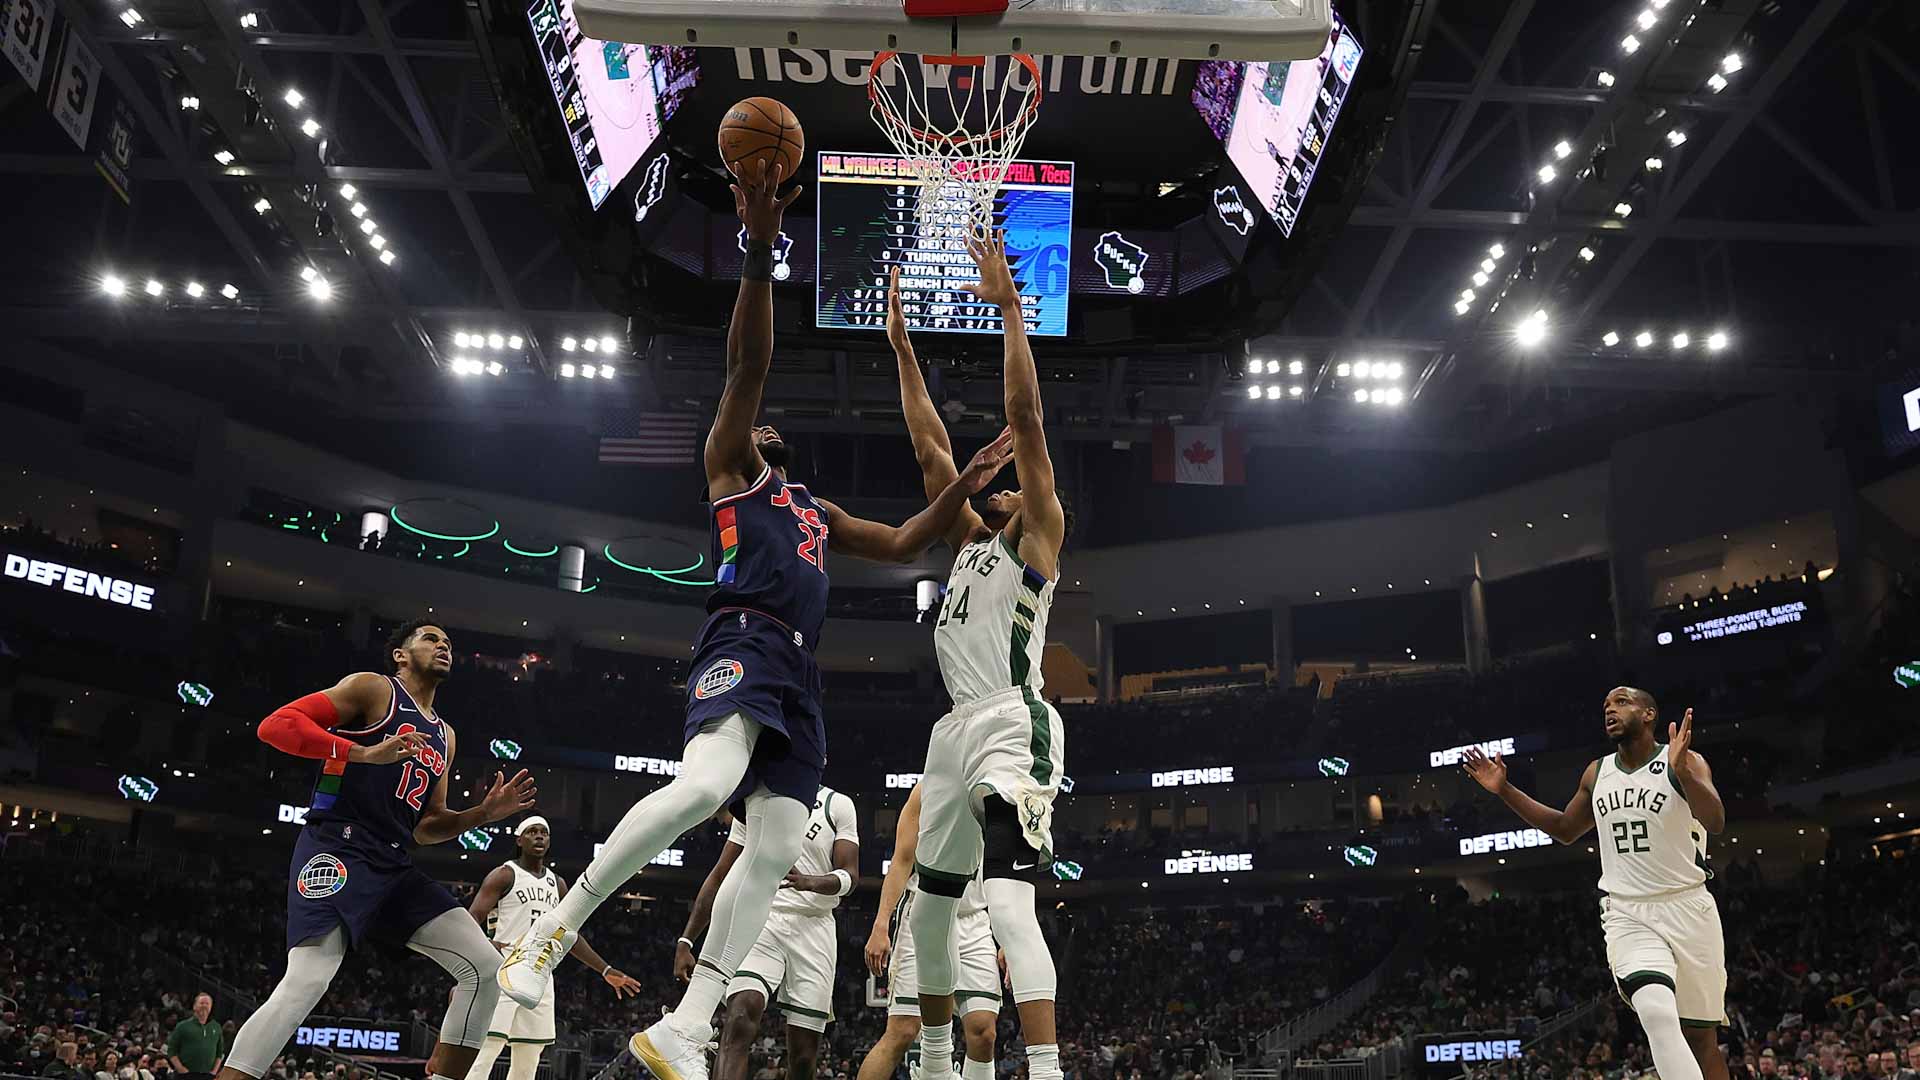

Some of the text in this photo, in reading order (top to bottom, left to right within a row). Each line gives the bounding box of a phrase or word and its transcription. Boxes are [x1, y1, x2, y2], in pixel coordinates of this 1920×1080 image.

[14, 0, 44, 62] 31
[557, 54, 571, 74] 9
[66, 64, 89, 115] 3
[1320, 87, 1333, 107] 8
[565, 103, 577, 124] 1ST
[571, 91, 586, 120] 8:02
[584, 137, 596, 155] 8
[822, 155, 897, 177] MILWAUKEE
[1040, 164, 1071, 184] 76ers
[1290, 165, 1302, 184] 9
[896, 186, 905, 195] 2
[896, 198, 905, 208] 0
[897, 211, 904, 221] 1
[895, 225, 905, 235] 0
[897, 238, 903, 248] 1
[882, 251, 981, 265] 0 TURNOVER
[1103, 243, 1137, 274] BUCKS
[883, 265, 889, 274] 1
[903, 265, 943, 277] TOTAL
[875, 278, 884, 287] 0
[898, 278, 941, 290] BENCH
[935, 292, 952, 303] FG
[930, 305, 956, 316] 3PT
[935, 318, 952, 329] FT
[798, 523, 825, 573] 21
[953, 548, 1001, 577] CKS
[4, 553, 155, 611] DEFENSE
[938, 585, 970, 627] 34
[1704, 627, 1725, 640] THIS
[1725, 619, 1758, 635] MEANS
[1758, 612, 1801, 629] T-SHIRTS
[615, 755, 684, 776] DEFENS
[395, 761, 430, 811] 12
[1151, 766, 1234, 787] DEFENSE
[1596, 787, 1667, 817] BUCKS
[1459, 828, 1552, 855] DEFENSE
[1611, 820, 1650, 854] 22
[1164, 853, 1253, 874] DEFENSE
[516, 887, 559, 909] BUCKS
[296, 1026, 400, 1051] DEFENSE
[1425, 1040, 1522, 1062] DEFENSE
